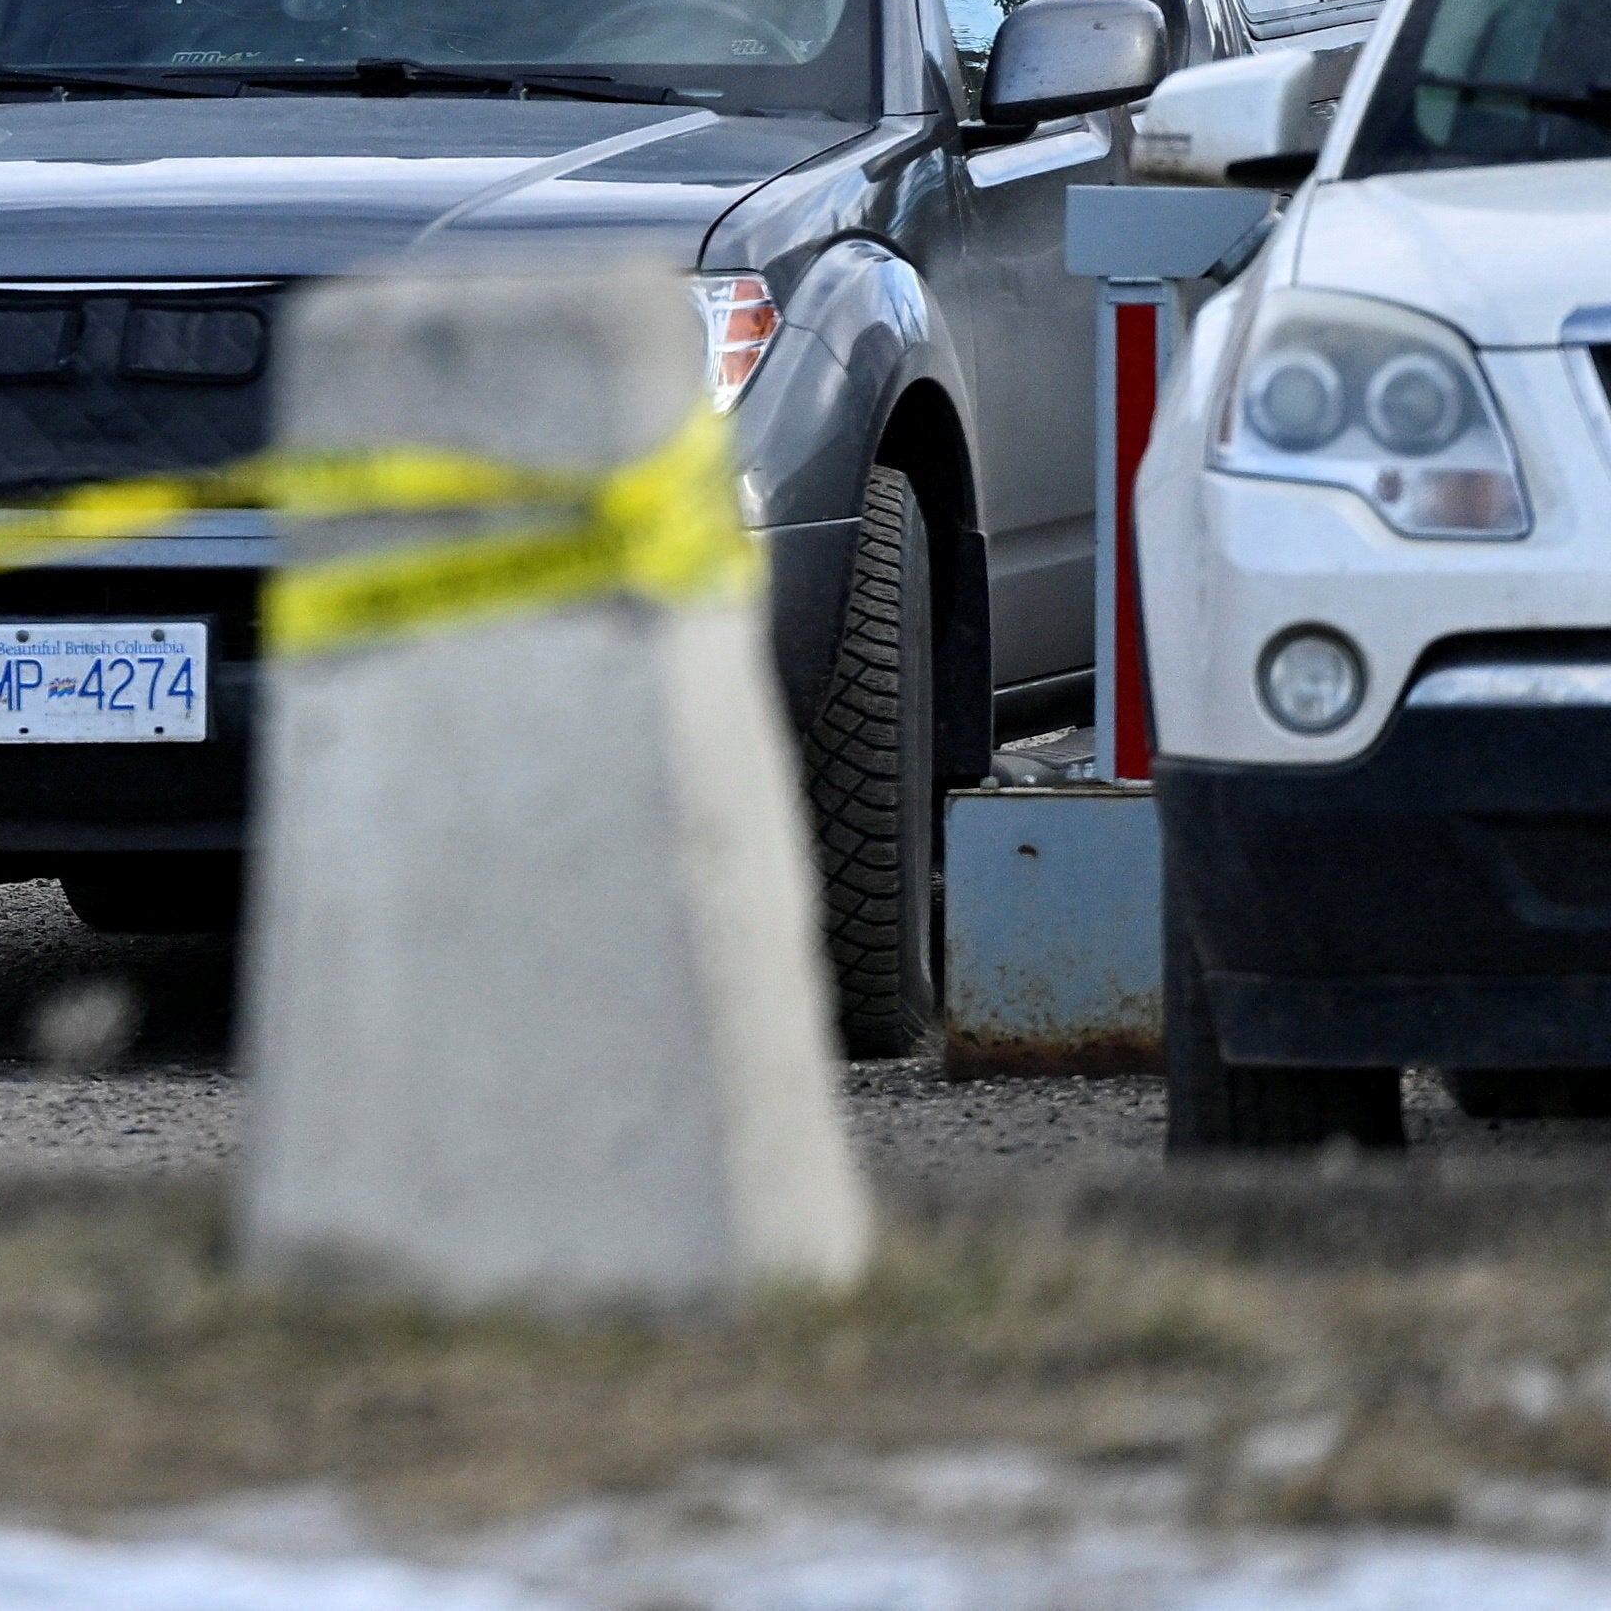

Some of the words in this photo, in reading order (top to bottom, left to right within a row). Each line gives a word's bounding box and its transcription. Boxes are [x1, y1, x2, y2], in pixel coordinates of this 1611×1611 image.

[65, 640, 110, 655] British
[114, 639, 185, 654] Columbia
[78, 657, 194, 711] 4274
